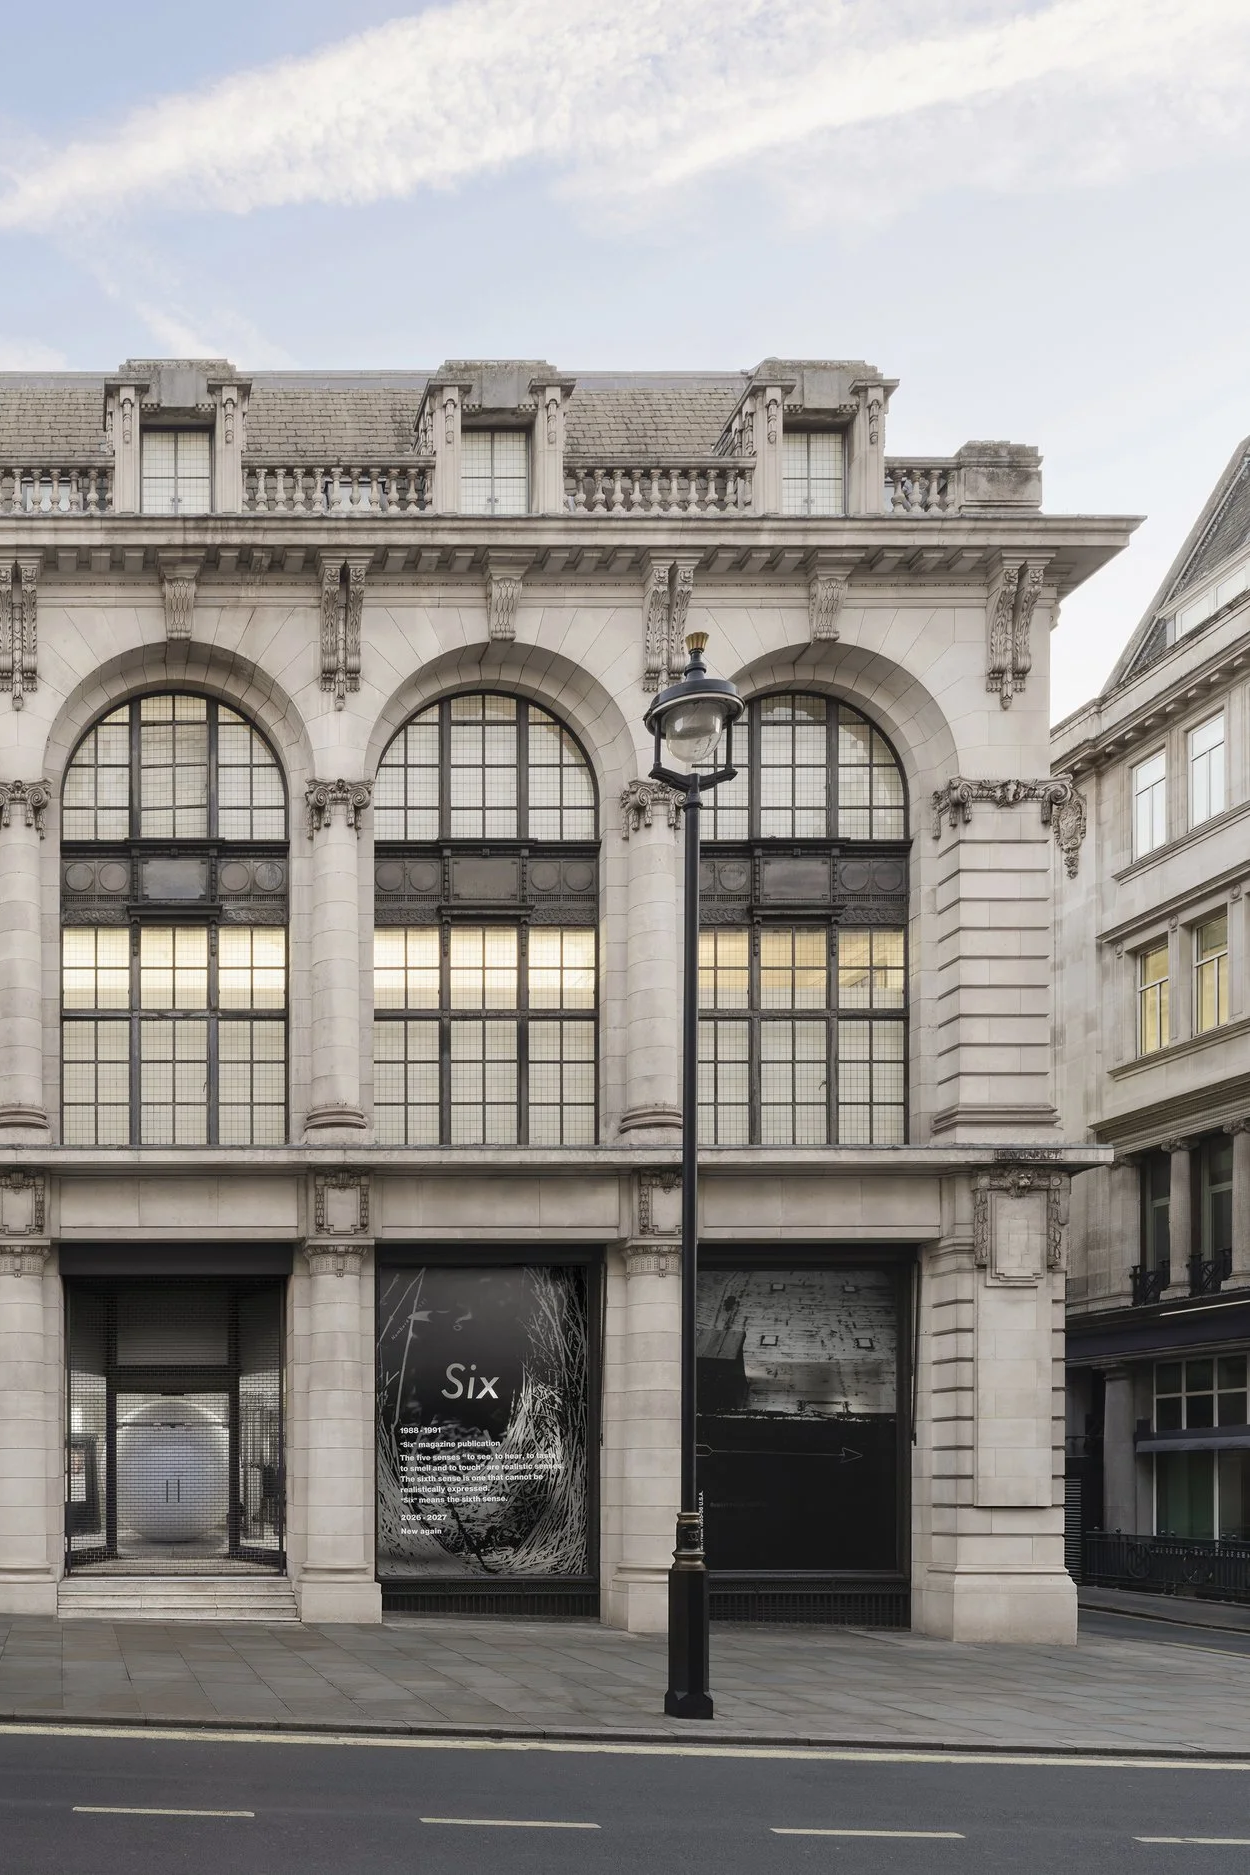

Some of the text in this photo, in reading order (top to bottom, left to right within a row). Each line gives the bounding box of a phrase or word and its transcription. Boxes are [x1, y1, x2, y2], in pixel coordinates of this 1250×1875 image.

[441, 1362, 500, 1399] Six
[400, 1426, 419, 1434] 1988
[424, 1426, 442, 1434] 1991
[418, 1441, 456, 1449] magazine
[457, 1440, 501, 1448] publication
[447, 1485, 490, 1493] expressed.
[420, 1527, 442, 1535] again
